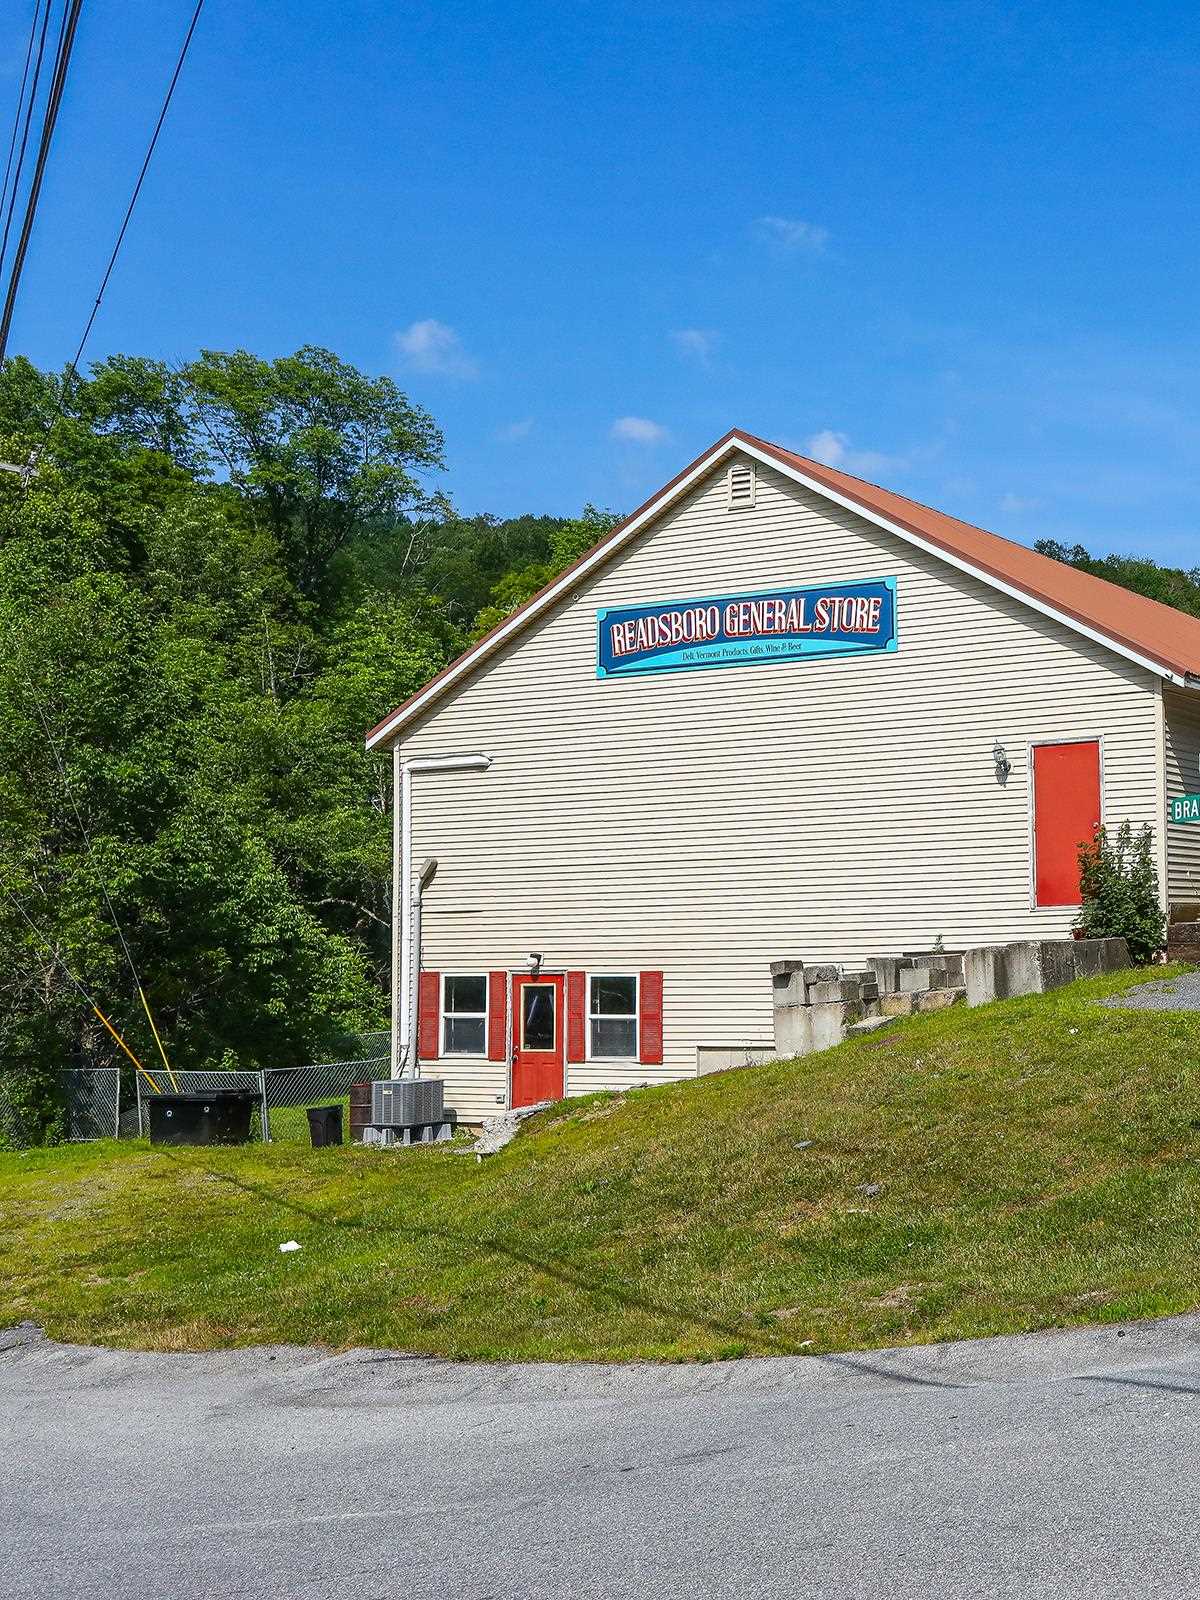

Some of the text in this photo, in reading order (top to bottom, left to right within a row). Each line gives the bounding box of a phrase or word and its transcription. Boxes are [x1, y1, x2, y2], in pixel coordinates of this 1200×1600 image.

[610, 596, 883, 657] READSBORO GENERAL STORE
[697, 650, 721, 660] Vermont
[788, 642, 802, 651] Beer
